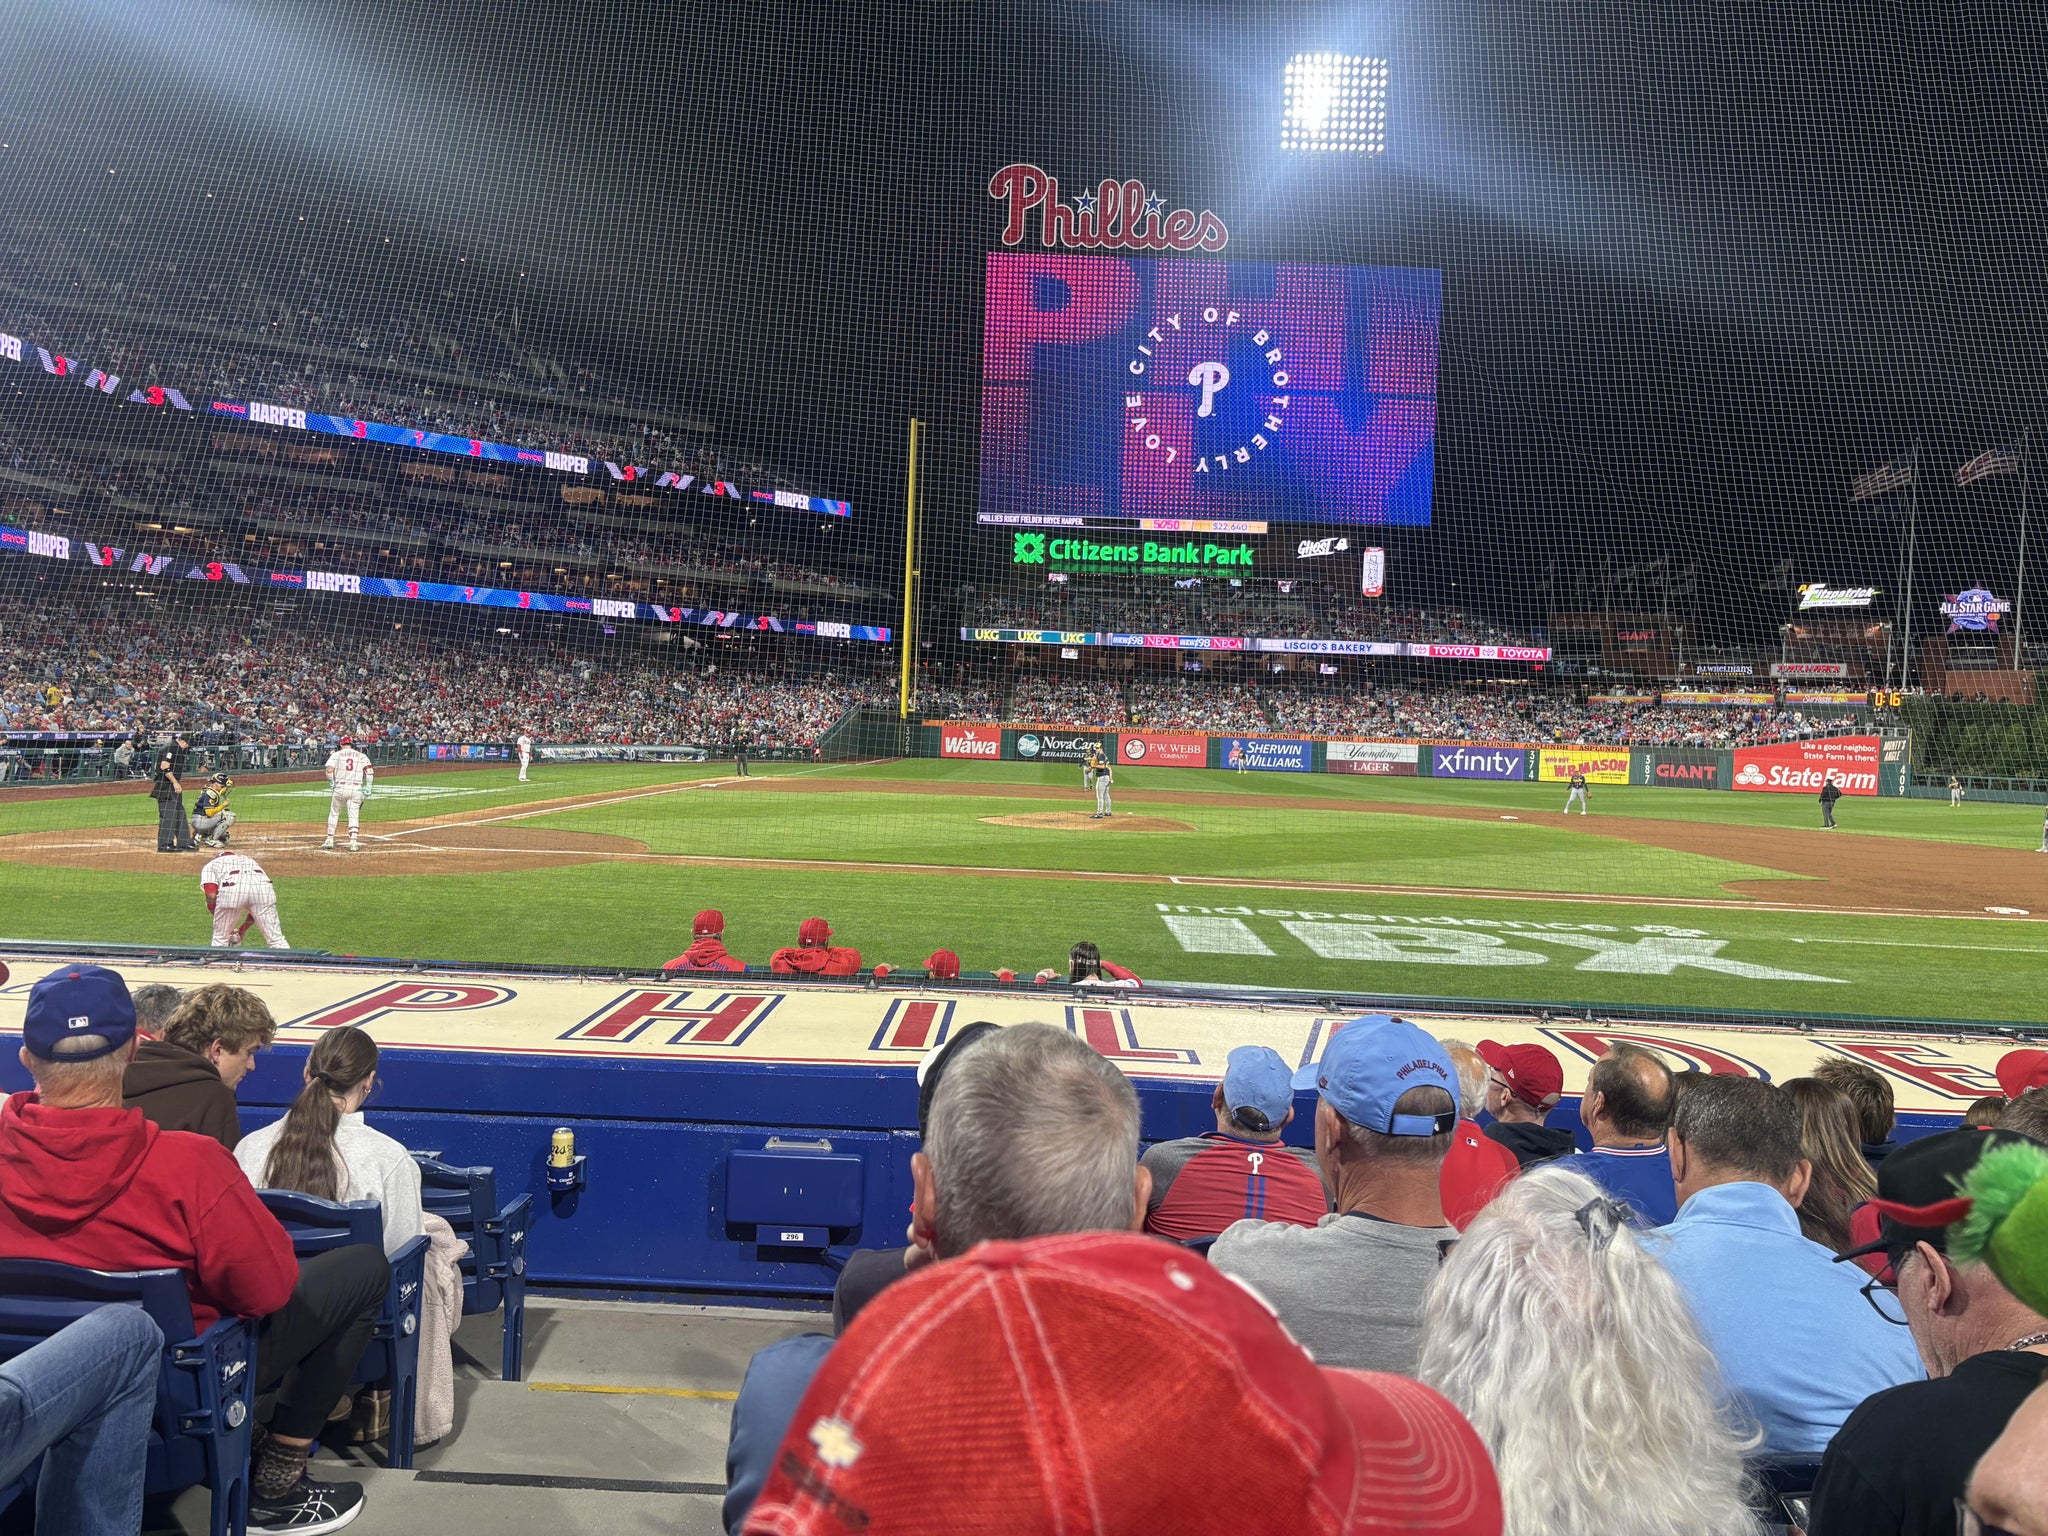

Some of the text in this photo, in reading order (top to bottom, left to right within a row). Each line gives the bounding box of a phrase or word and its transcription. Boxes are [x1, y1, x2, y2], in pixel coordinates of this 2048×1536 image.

[989, 164, 1229, 252] Phillies
[0, 333, 21, 361] PER
[1126, 307, 1289, 473] CITY OF BROTHERLY LOVE
[213, 401, 306, 429] BRYCE HARPER
[546, 452, 588, 474] HARPER
[775, 490, 809, 510] HARPER
[980, 514, 1003, 523] PHILLIES
[1004, 515, 1020, 523] RIGHT
[1020, 515, 1042, 524] FIELDER
[1043, 516, 1060, 524] BRYCE
[2, 531, 69, 559] BRYCE HARPER
[1297, 538, 1339, 557] GHOST
[1049, 539, 1254, 566] Citizens Bank Park
[271, 571, 360, 593] BRYCE HARPER
[593, 599, 635, 618] HARPER
[1984, 601, 2010, 612] GAME
[817, 621, 850, 638] HARPER
[975, 629, 999, 640] UKG
[1018, 630, 1042, 642] UKG
[1061, 632, 1085, 643] UKG
[1147, 636, 1177, 646] NECA
[1213, 638, 1242, 649] NECA
[1284, 642, 1372, 652] LISCIO'S BAKERY
[1433, 646, 1476, 656] TOYOTA
[1502, 649, 1543, 658] TOYOTA
[944, 720, 987, 728] ASPLUNDH
[995, 722, 1038, 730] ASPLUNDH
[1256, 732, 1301, 740] ASPLUNDH
[1309, 734, 1354, 742] ASPLUNDH
[1362, 736, 1408, 744] ASPLUNDH
[945, 736, 998, 755] Wawa
[1149, 743, 1201, 754] F.W. WEBB
[1247, 741, 1302, 755] SHERWIN
[1415, 738, 1461, 747] ASPLUNDH
[1470, 740, 1515, 748] ASPLUNDH
[1524, 742, 1569, 751] ASPLUNDH
[1579, 744, 1623, 752] ASPLUNDH
[1800, 742, 1816, 750] Like
[1823, 744, 1842, 752] good
[1843, 744, 1877, 753] neighbor,
[1344, 744, 1401, 760] Yuengling
[1803, 752, 1824, 760] State
[1826, 753, 1845, 761] Farm
[1884, 751, 1901, 762] ANGLE
[346, 758, 353, 771] 3
[1353, 762, 1390, 772] LAGER
[1438, 748, 1519, 775] xfinity
[1578, 759, 1627, 775] MASON
[1655, 763, 1717, 780] GIANT
[1155, 902, 1618, 933] Independence
[1160, 914, 1851, 983] IBX
[1396, 1059, 1447, 1081] PHILADELPHIA
[1247, 1152, 1264, 1175] P
